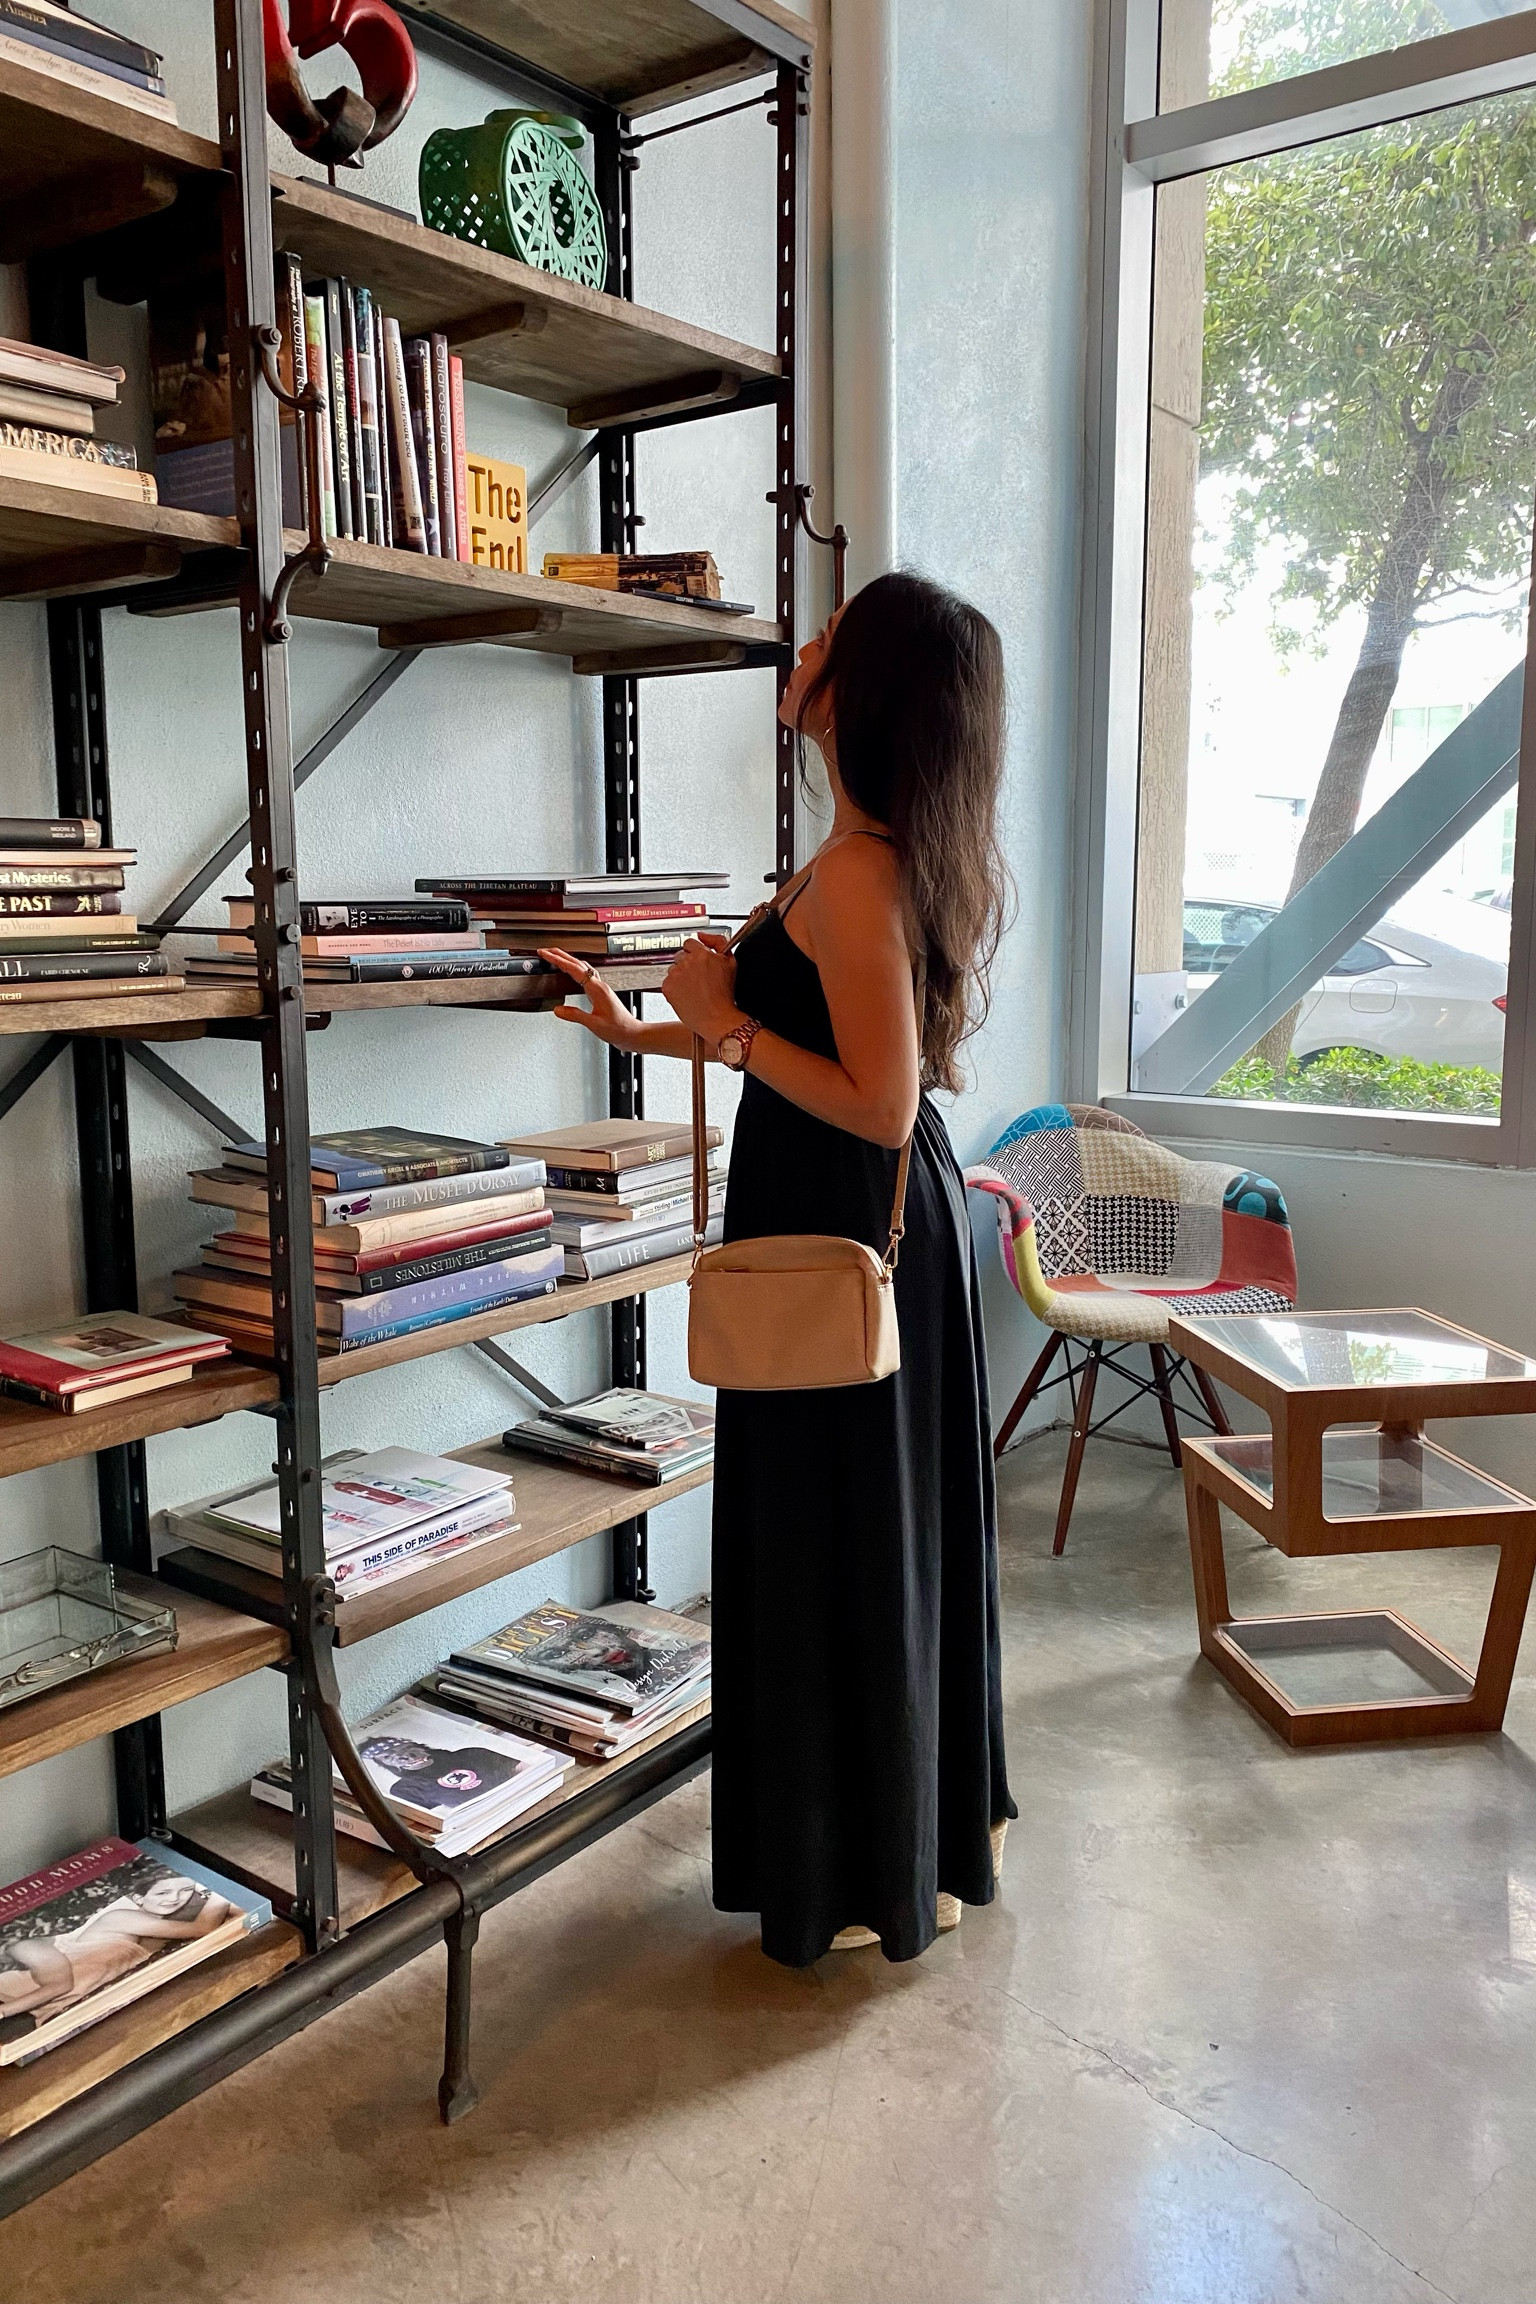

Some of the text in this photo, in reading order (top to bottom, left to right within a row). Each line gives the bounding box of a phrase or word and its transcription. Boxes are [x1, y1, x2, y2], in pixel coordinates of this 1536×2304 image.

[5, 1, 48, 26] America
[293, 313, 306, 374] ROBERT
[334, 352, 343, 372] At
[335, 372, 345, 393] the
[436, 343, 448, 454] Chiaroscuro
[454, 370, 464, 448] TRESPASSING
[336, 394, 348, 439] Temple
[340, 458, 350, 482] Art
[457, 450, 466, 498] Houses
[468, 464, 521, 524] The
[472, 526, 522, 573] End
[12, 871, 72, 887] Mysteries
[438, 882, 462, 890] ACROSS
[479, 882, 507, 890] TIBETAN
[509, 882, 538, 890] PLATEAU
[10, 895, 53, 912] PAST
[11, 919, 51, 932] Women
[350, 908, 358, 929] EYE
[359, 910, 368, 927] TO
[383, 939, 394, 948] The
[635, 934, 681, 951] American
[428, 964, 444, 974] 100
[474, 961, 509, 972] Basketball
[385, 1195, 408, 1211] THE
[411, 1181, 463, 1206] MUSÉE
[466, 1172, 521, 1195] D'ORSAY
[654, 1201, 671, 1212] Stirling
[672, 1194, 690, 1206] Michael
[464, 1249, 487, 1262] THE
[617, 1243, 651, 1267] LIFE
[395, 1255, 462, 1283] MILESTONES
[411, 1271, 510, 1305] FIRE WITHIN
[362, 1522, 460, 1568] THIS SIDE OF PARADISE
[483, 1607, 581, 1661] DIGEST
[623, 1667, 654, 1694] Design
[359, 1705, 402, 1730] SURFACE
[49, 1845, 114, 1879] MOMS
